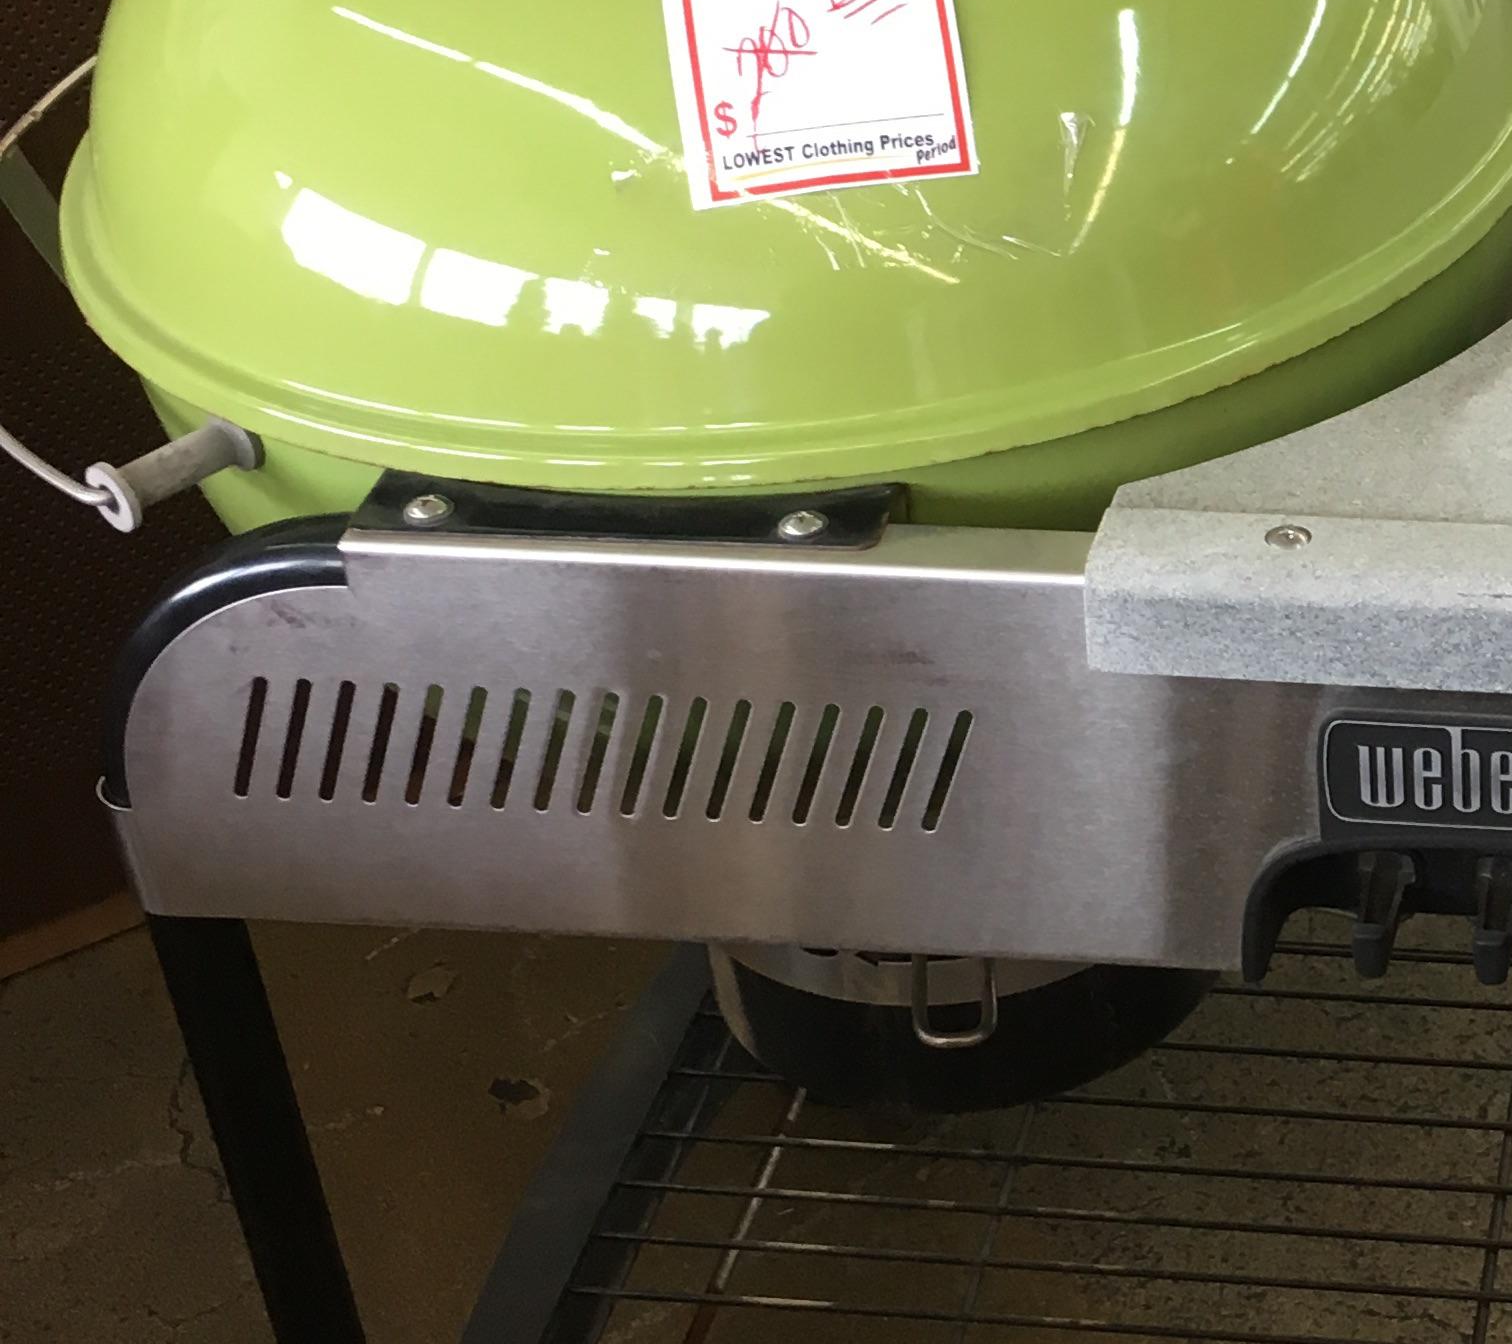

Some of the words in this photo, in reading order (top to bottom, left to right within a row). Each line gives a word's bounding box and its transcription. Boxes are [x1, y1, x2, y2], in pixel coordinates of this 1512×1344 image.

[714, 101, 737, 139] $
[723, 146, 794, 170] LOWEST
[802, 139, 874, 158] Clothing
[880, 132, 934, 149] Prices
[916, 136, 956, 164] Period
